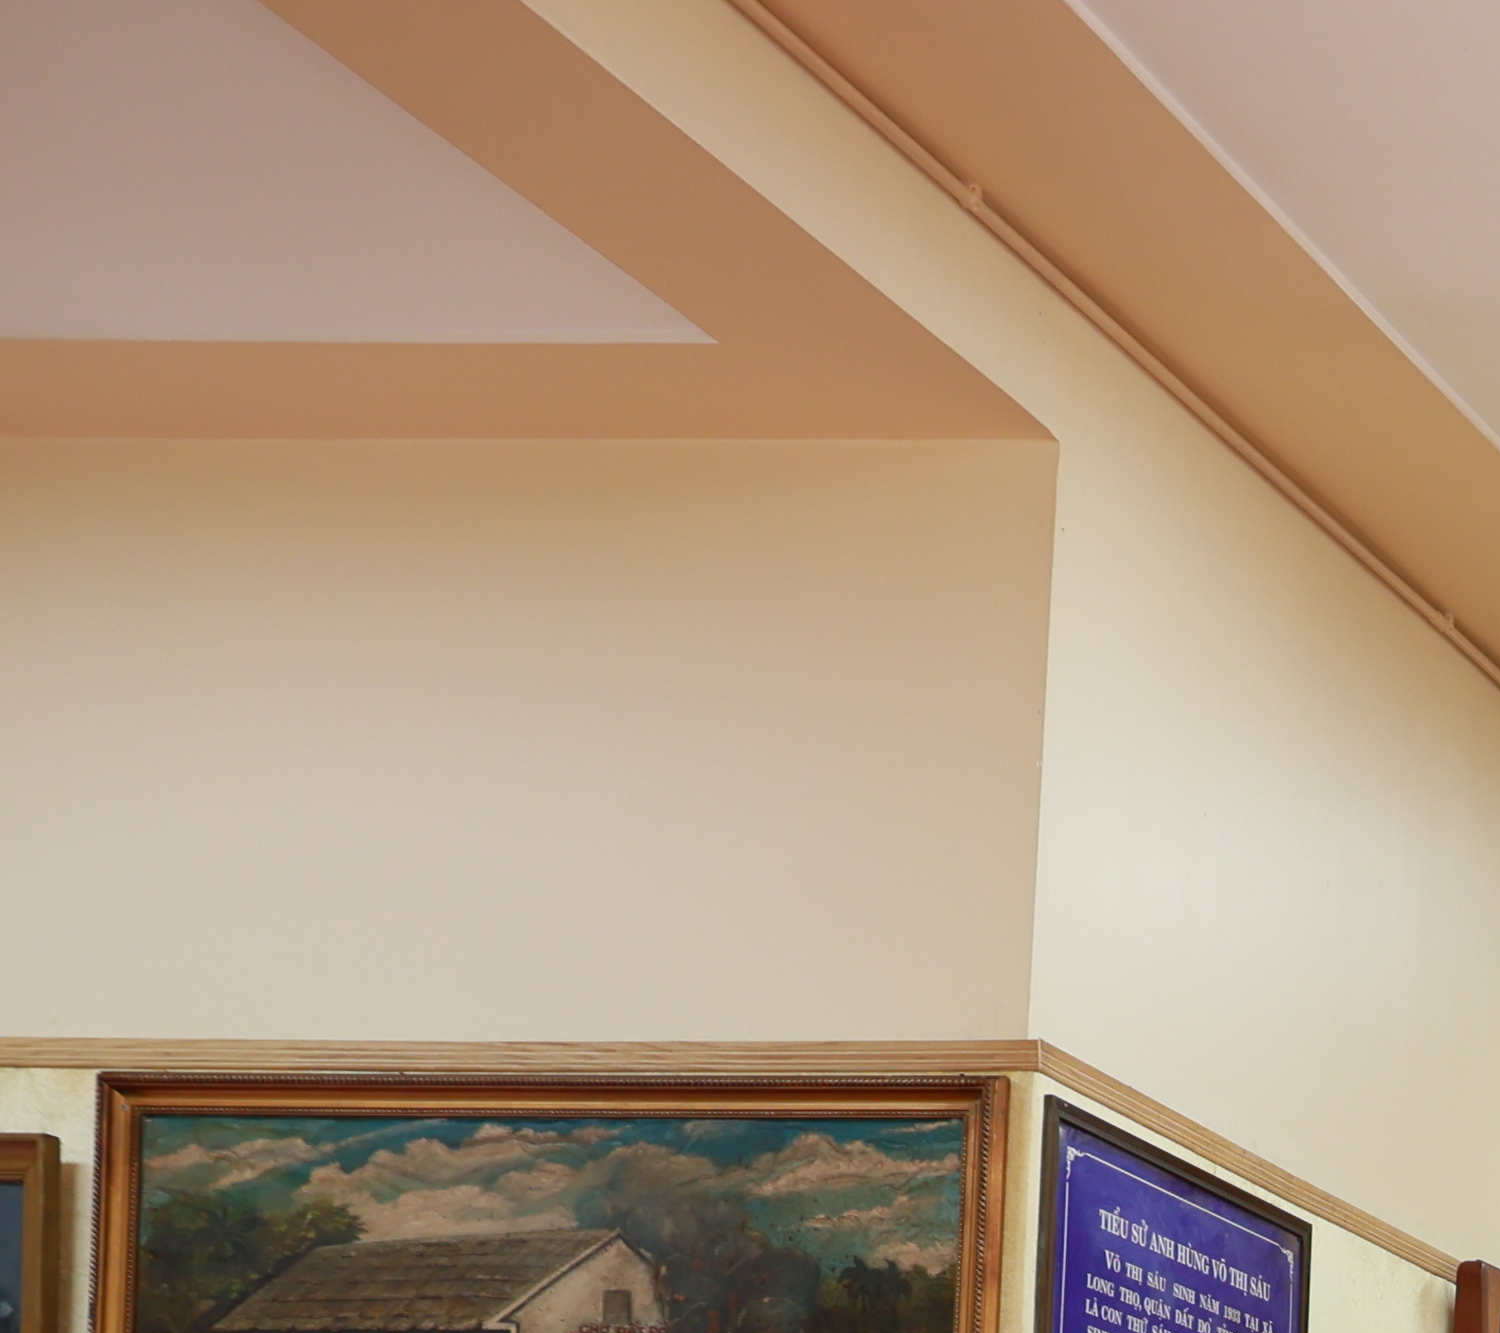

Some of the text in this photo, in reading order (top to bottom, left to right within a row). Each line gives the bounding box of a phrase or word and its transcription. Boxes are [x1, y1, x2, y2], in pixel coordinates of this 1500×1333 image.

[1098, 1208, 1129, 1239] TIỂU
[1131, 1220, 1149, 1247] SỬ
[1149, 1232, 1175, 1260] ANH
[1211, 1257, 1227, 1283] VÕ
[1229, 1266, 1248, 1296] THỊ
[1249, 1274, 1271, 1302] SÁU
[1104, 1249, 1121, 1273] VÕ
[1125, 1262, 1143, 1283] THỊ
[1147, 1270, 1167, 1292] SÁU
[1172, 1282, 1196, 1305] SINH
[1199, 1293, 1220, 1315] NĂM
[1244, 1313, 1259, 1332] TẠI
[1086, 1272, 1115, 1298] LONG
[1143, 1296, 1172, 1320] QUẬN
[1174, 1307, 1194, 1330] ĐẤT
